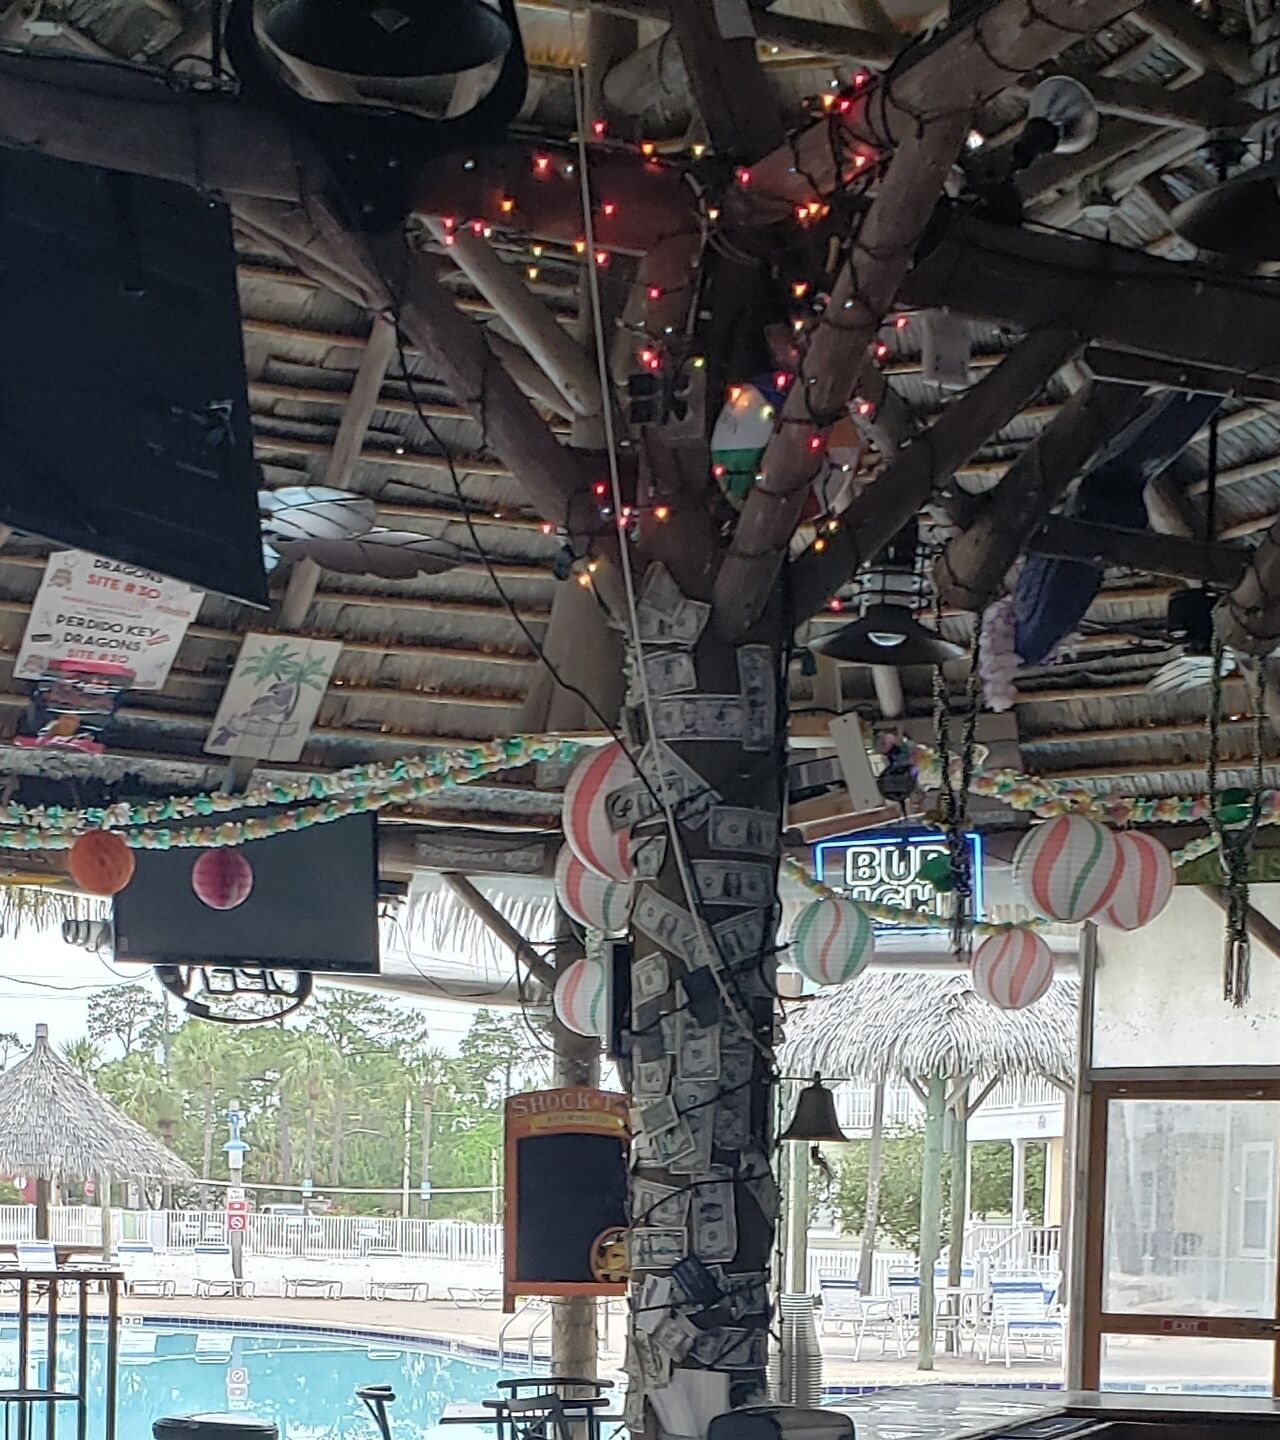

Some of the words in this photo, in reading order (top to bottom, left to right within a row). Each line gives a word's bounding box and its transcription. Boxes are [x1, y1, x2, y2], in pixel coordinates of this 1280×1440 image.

[87, 573, 119, 593] SITE
[93, 559, 163, 584] DRAGONS
[56, 614, 123, 633] PERDIDO
[127, 625, 160, 637] KEY
[63, 632, 141, 651] DRAGONS
[511, 1093, 591, 1118] SHOCK
